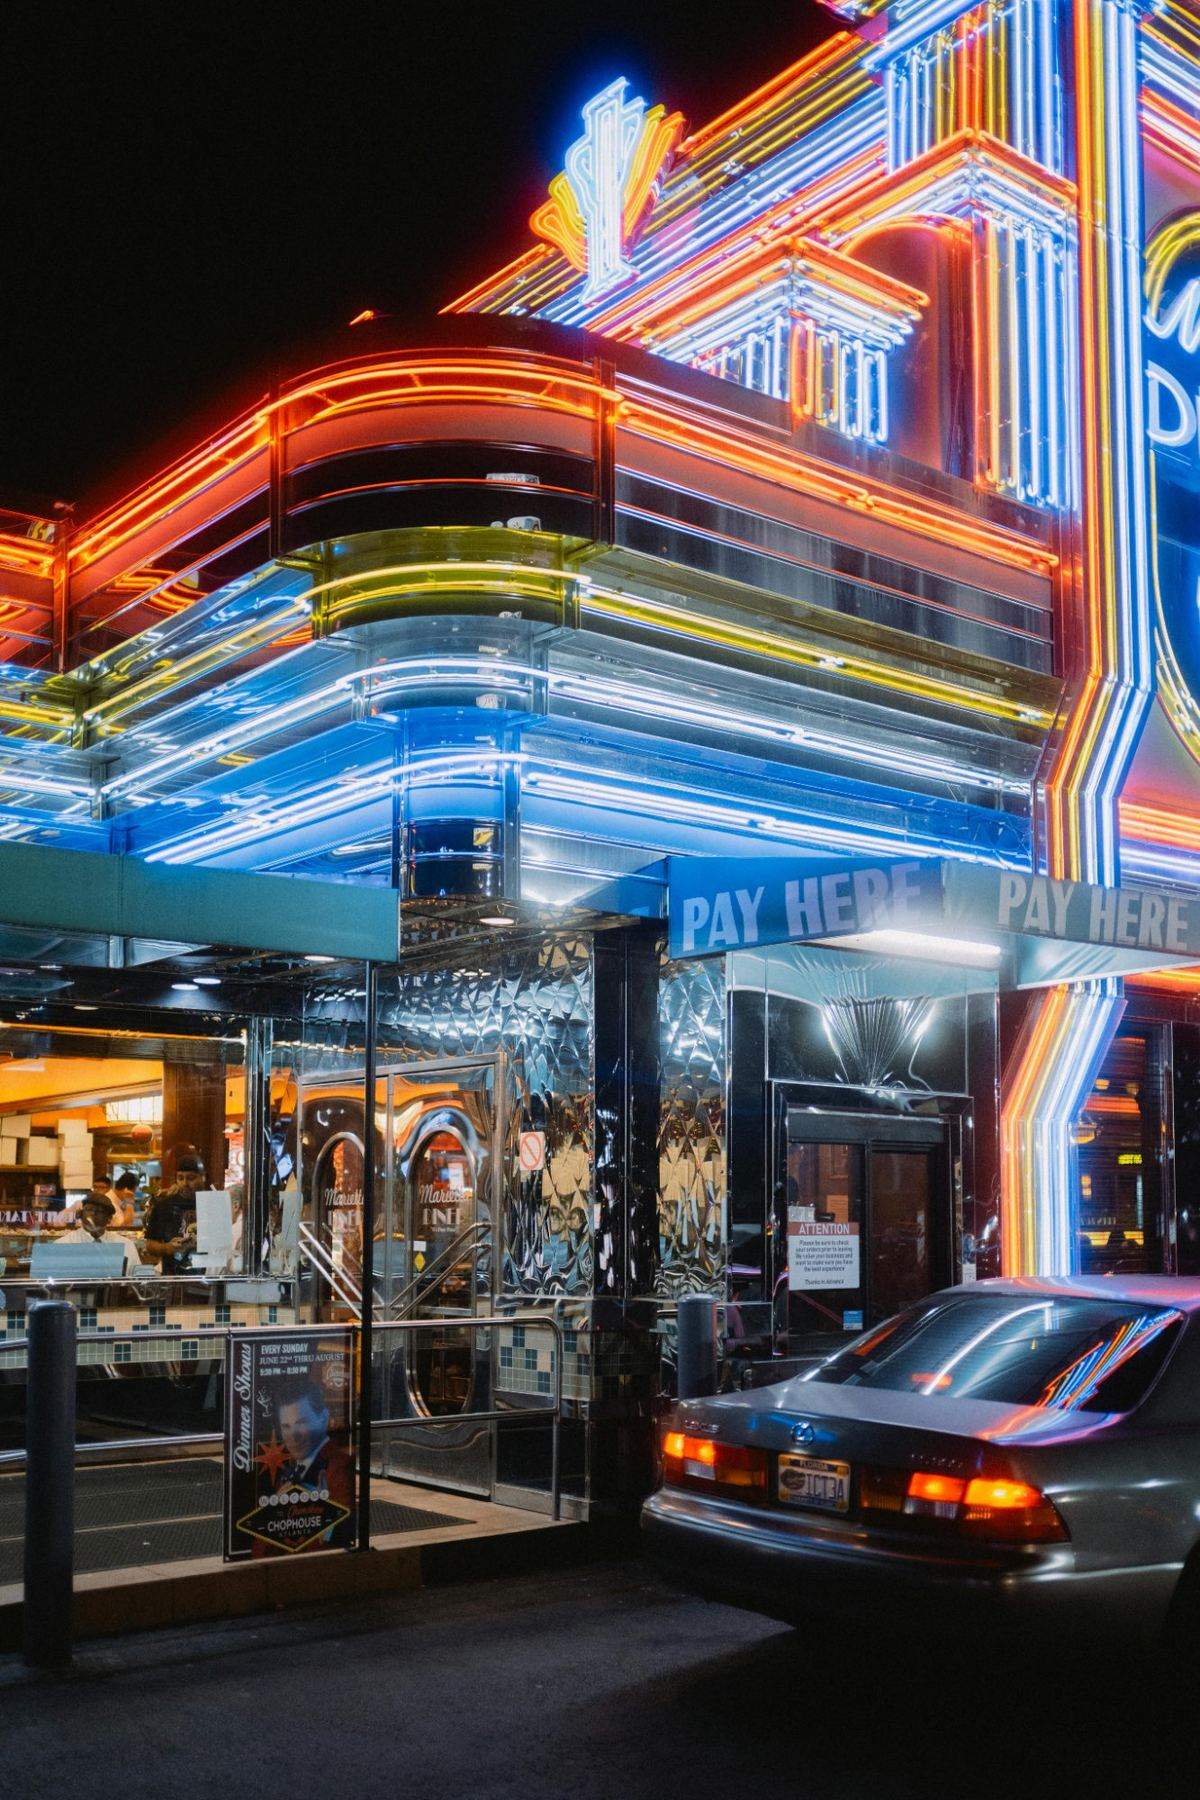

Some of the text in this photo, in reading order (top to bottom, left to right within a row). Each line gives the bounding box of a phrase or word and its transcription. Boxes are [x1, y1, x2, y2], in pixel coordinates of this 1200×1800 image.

[683, 861, 922, 952] PAY HERE
[998, 868, 1189, 951] PAY HERE
[799, 1224, 850, 1235] ATTENTION
[261, 1343, 308, 1355] EVERY SUNDAY
[259, 1356, 279, 1365] JUNE
[294, 1353, 315, 1363] THRU
[316, 1352, 344, 1362] AUGUST
[273, 1367, 281, 1376] PM
[300, 1366, 308, 1374] PM
[233, 1342, 251, 1473] Dinner Shows
[258, 1489, 330, 1508] WELCOME
[267, 1516, 321, 1532] CHOPHOUSE
